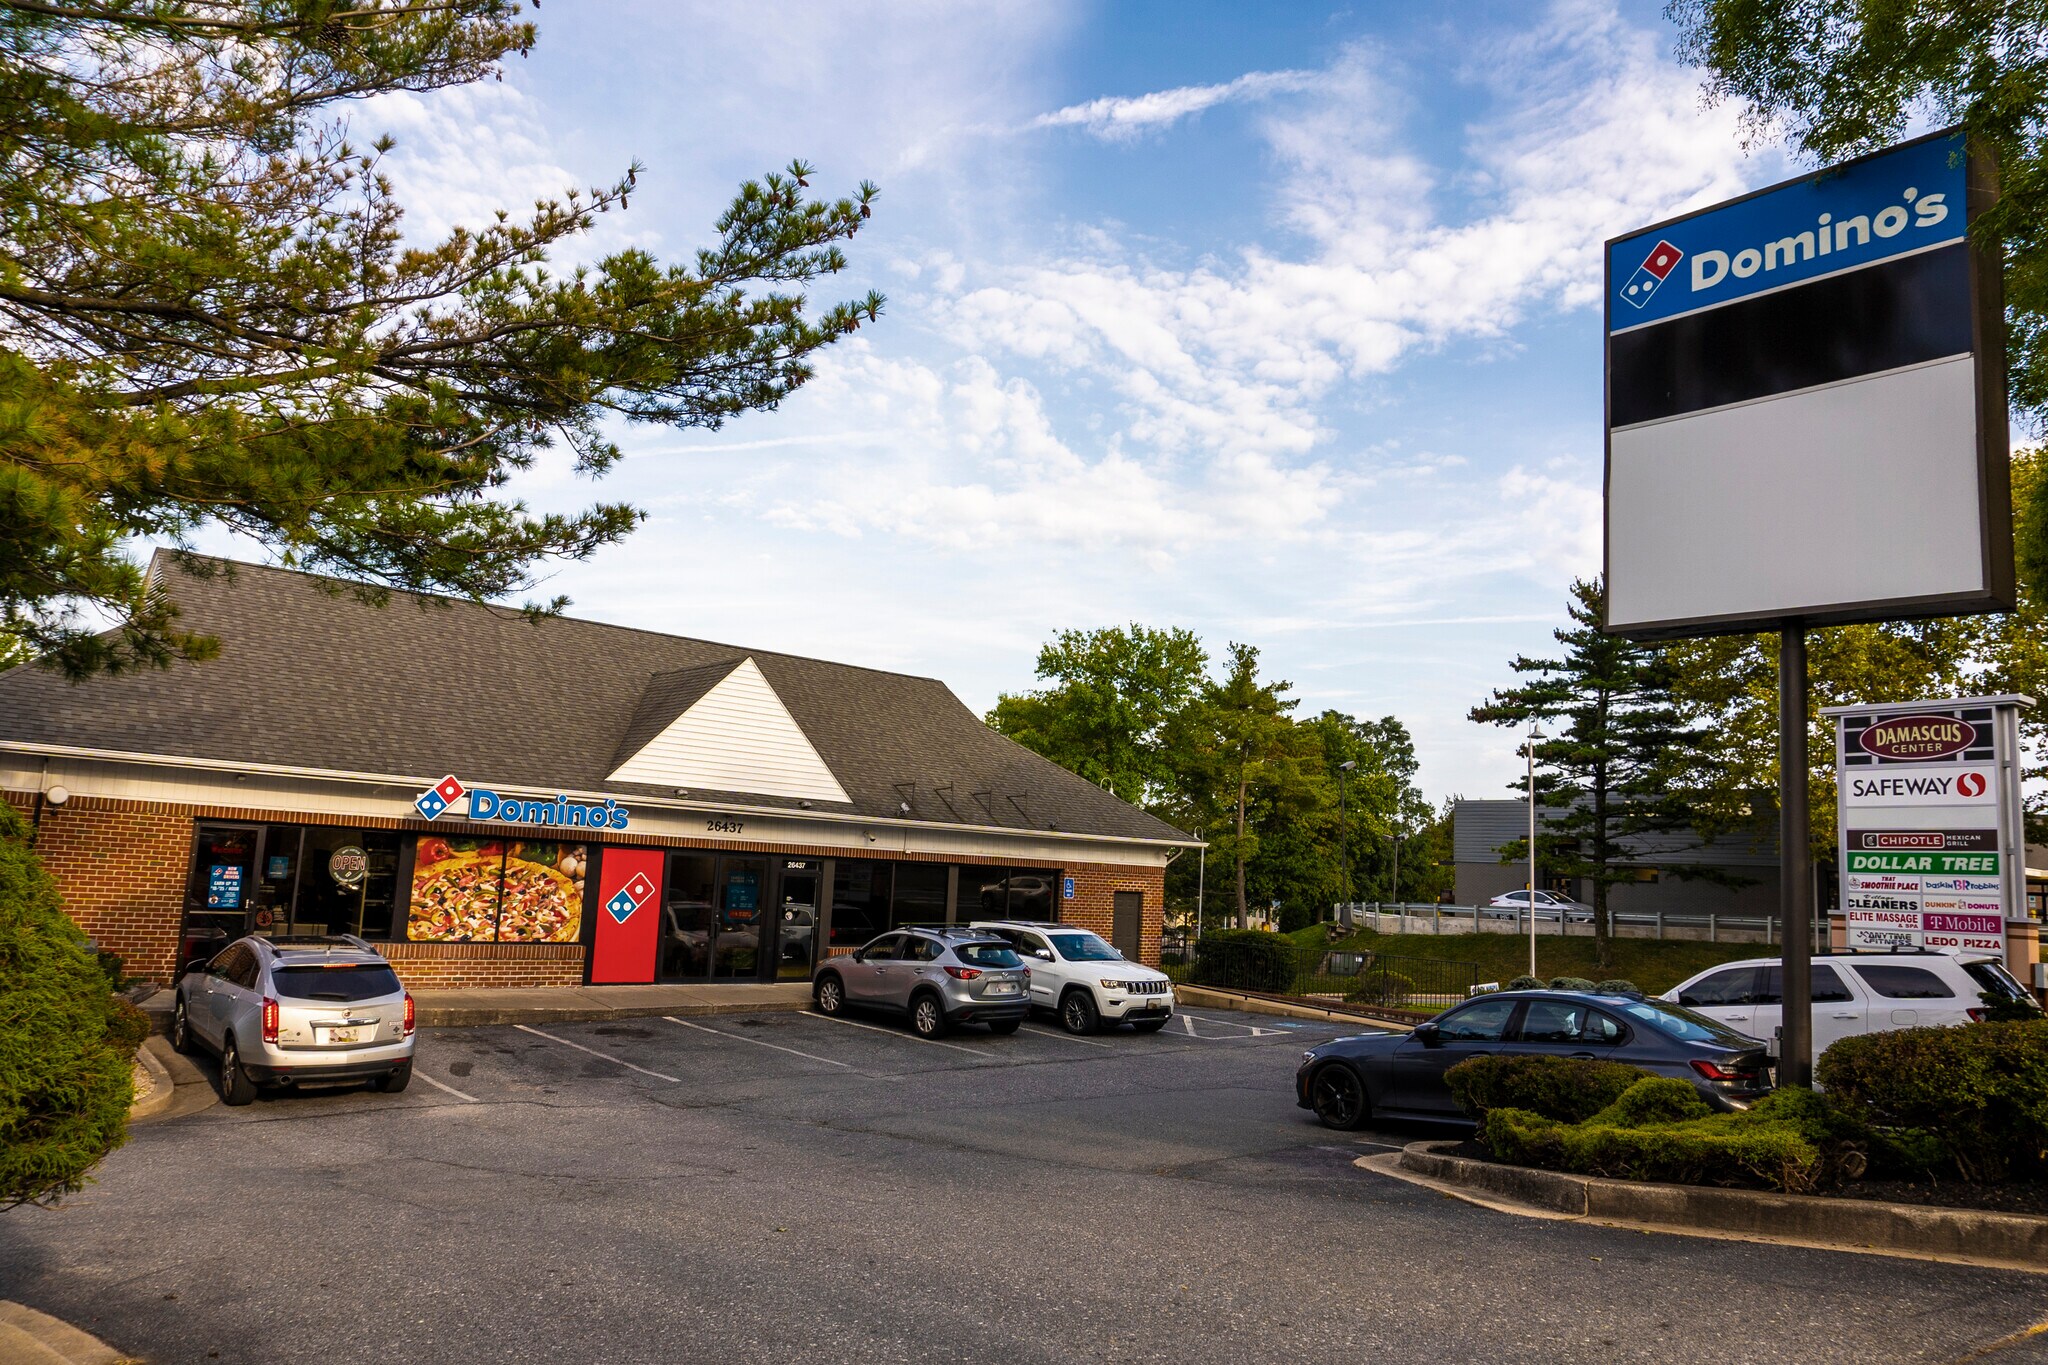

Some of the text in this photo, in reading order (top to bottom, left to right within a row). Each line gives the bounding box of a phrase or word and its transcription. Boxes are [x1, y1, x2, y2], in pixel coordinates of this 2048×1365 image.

[1691, 186, 1949, 293] Domino's
[1875, 723, 1962, 747] DAMASCUS
[1892, 743, 1943, 754] CENTER
[1853, 777, 1953, 797] SAFEWAY
[469, 788, 629, 830] Domino's
[706, 820, 744, 834] 26437
[1880, 836, 1941, 845] CHIPOTLE
[333, 855, 366, 870] OPEN
[787, 861, 806, 869] 26437
[1853, 856, 1994, 871] DOLLAR TREE
[1860, 882, 1919, 891] SMOOTHIE PLACE
[1925, 881, 1953, 889] baskin
[1970, 882, 2000, 890] robbins
[1848, 899, 1918, 911] CLEANERS
[1849, 911, 1919, 924] ELITE MASSAGE
[1945, 916, 1996, 932] Mobile
[1867, 938, 1912, 946] FITNESS
[1869, 932, 1912, 940] ANYTIME
[1925, 936, 2001, 949] LEDO PIZZA
